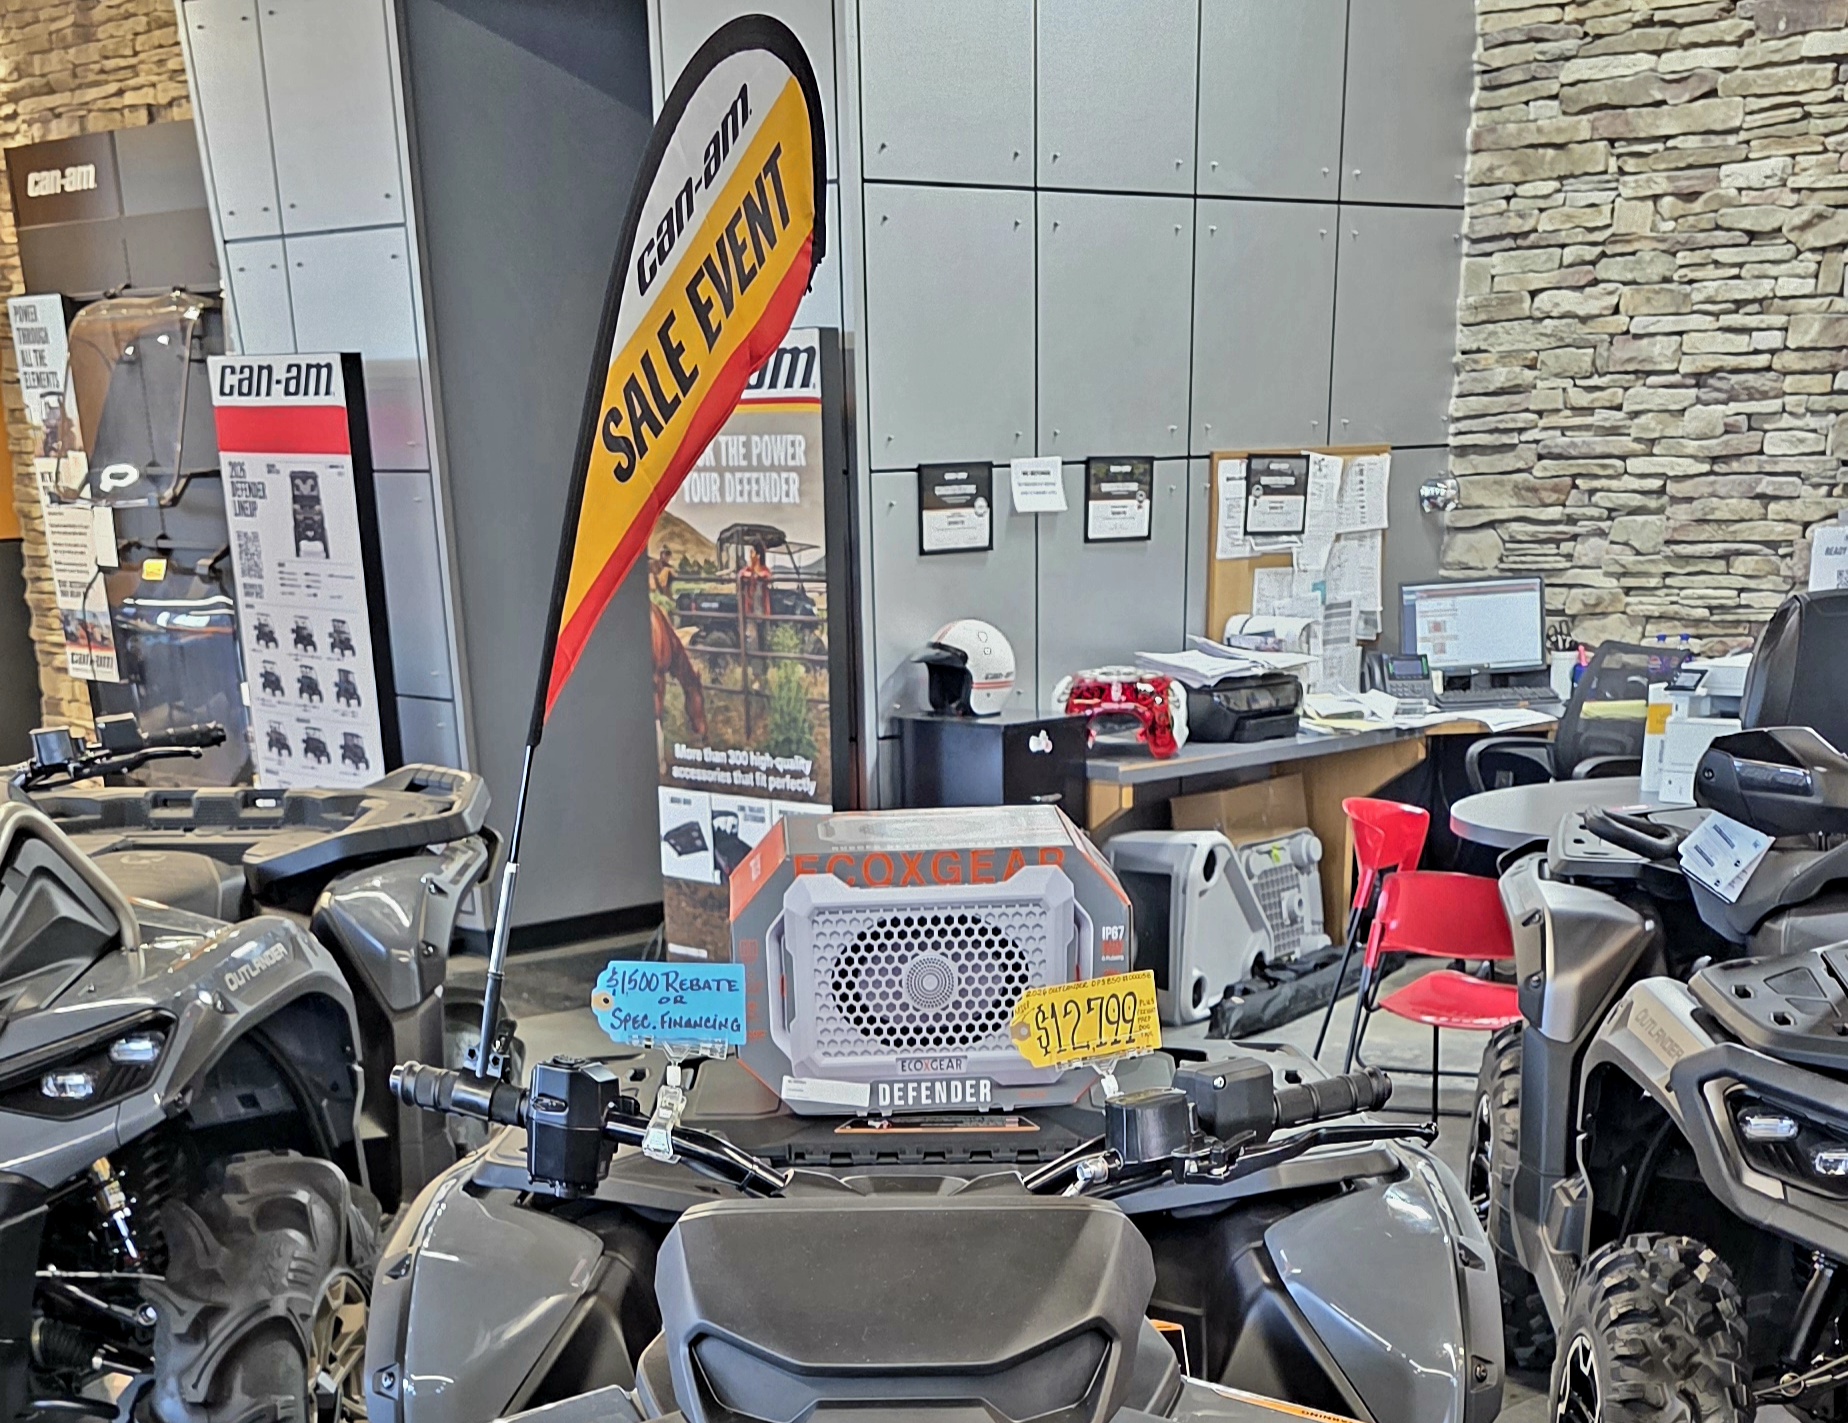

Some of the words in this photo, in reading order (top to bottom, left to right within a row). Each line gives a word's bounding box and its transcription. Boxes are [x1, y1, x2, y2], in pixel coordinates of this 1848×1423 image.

[27, 163, 96, 197] can-am
[637, 83, 749, 296] can-am
[13, 305, 38, 323] POWER
[602, 309, 699, 483] SALE
[685, 142, 790, 354] EVENT
[33, 349, 48, 367] THE
[23, 371, 60, 389] ELEMENTS
[219, 362, 333, 396] can-am
[718, 435, 748, 467] THE
[751, 434, 806, 467] POWER
[684, 471, 722, 504] YOUR
[724, 471, 800, 504] DEFENDER
[675, 743, 703, 762] More
[703, 747, 727, 764] than
[672, 765, 732, 785] accessories
[733, 769, 755, 787] that
[755, 771, 767, 788] fit
[768, 774, 817, 797] perfectly
[1101, 925, 1125, 941] IP67
[224, 942, 288, 992] OUTLANDER
[660, 970, 739, 993] REBATE
[658, 995, 688, 1005] OR
[660, 1010, 741, 1032] FINANCING
[1035, 991, 1137, 1057] $12,799
[1634, 1008, 1684, 1061] OUTLANDER
[901, 1058, 962, 1072] ECOXGEAR
[878, 1079, 992, 1106] DEFENDER
